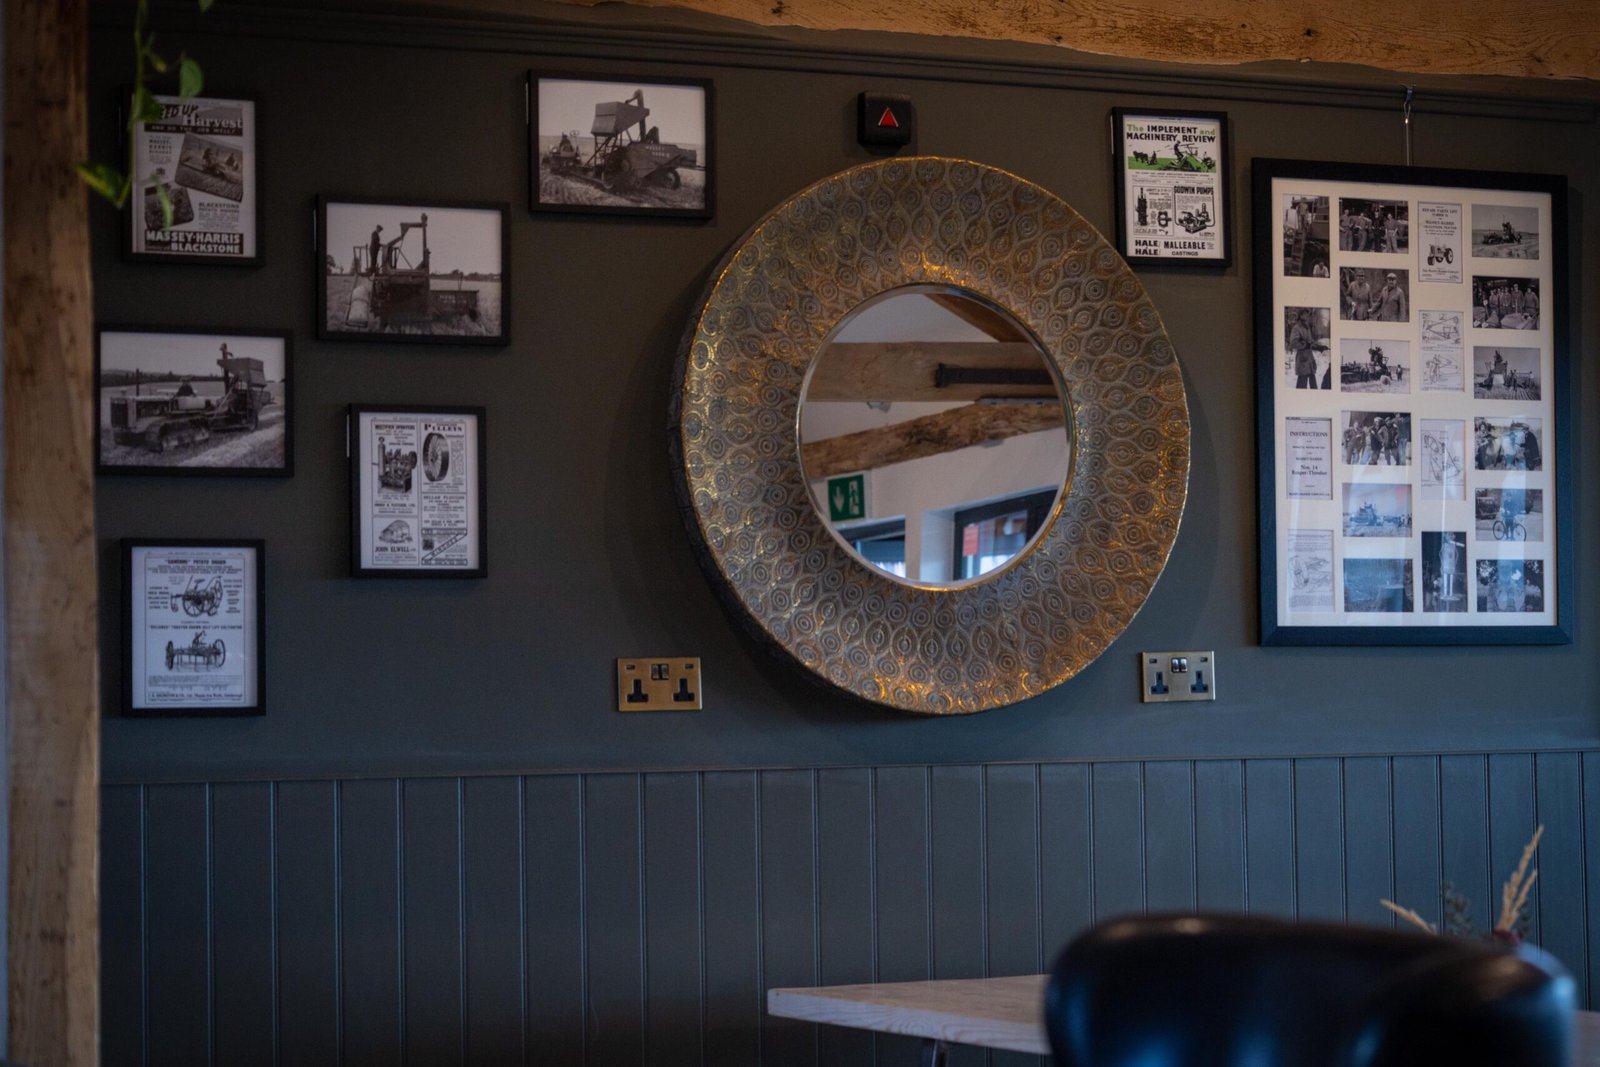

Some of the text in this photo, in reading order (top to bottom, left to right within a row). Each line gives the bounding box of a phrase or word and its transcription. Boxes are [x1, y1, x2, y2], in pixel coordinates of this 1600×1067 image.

[182, 112, 243, 129] Harvest
[1127, 124, 1216, 136] The IMPLEMENT and
[1127, 132, 1216, 143] MACHINERY REVIEW
[1197, 187, 1214, 195] PUMPS
[171, 242, 240, 253] BLACKSTONE
[1164, 241, 1206, 250] MALLEABLE
